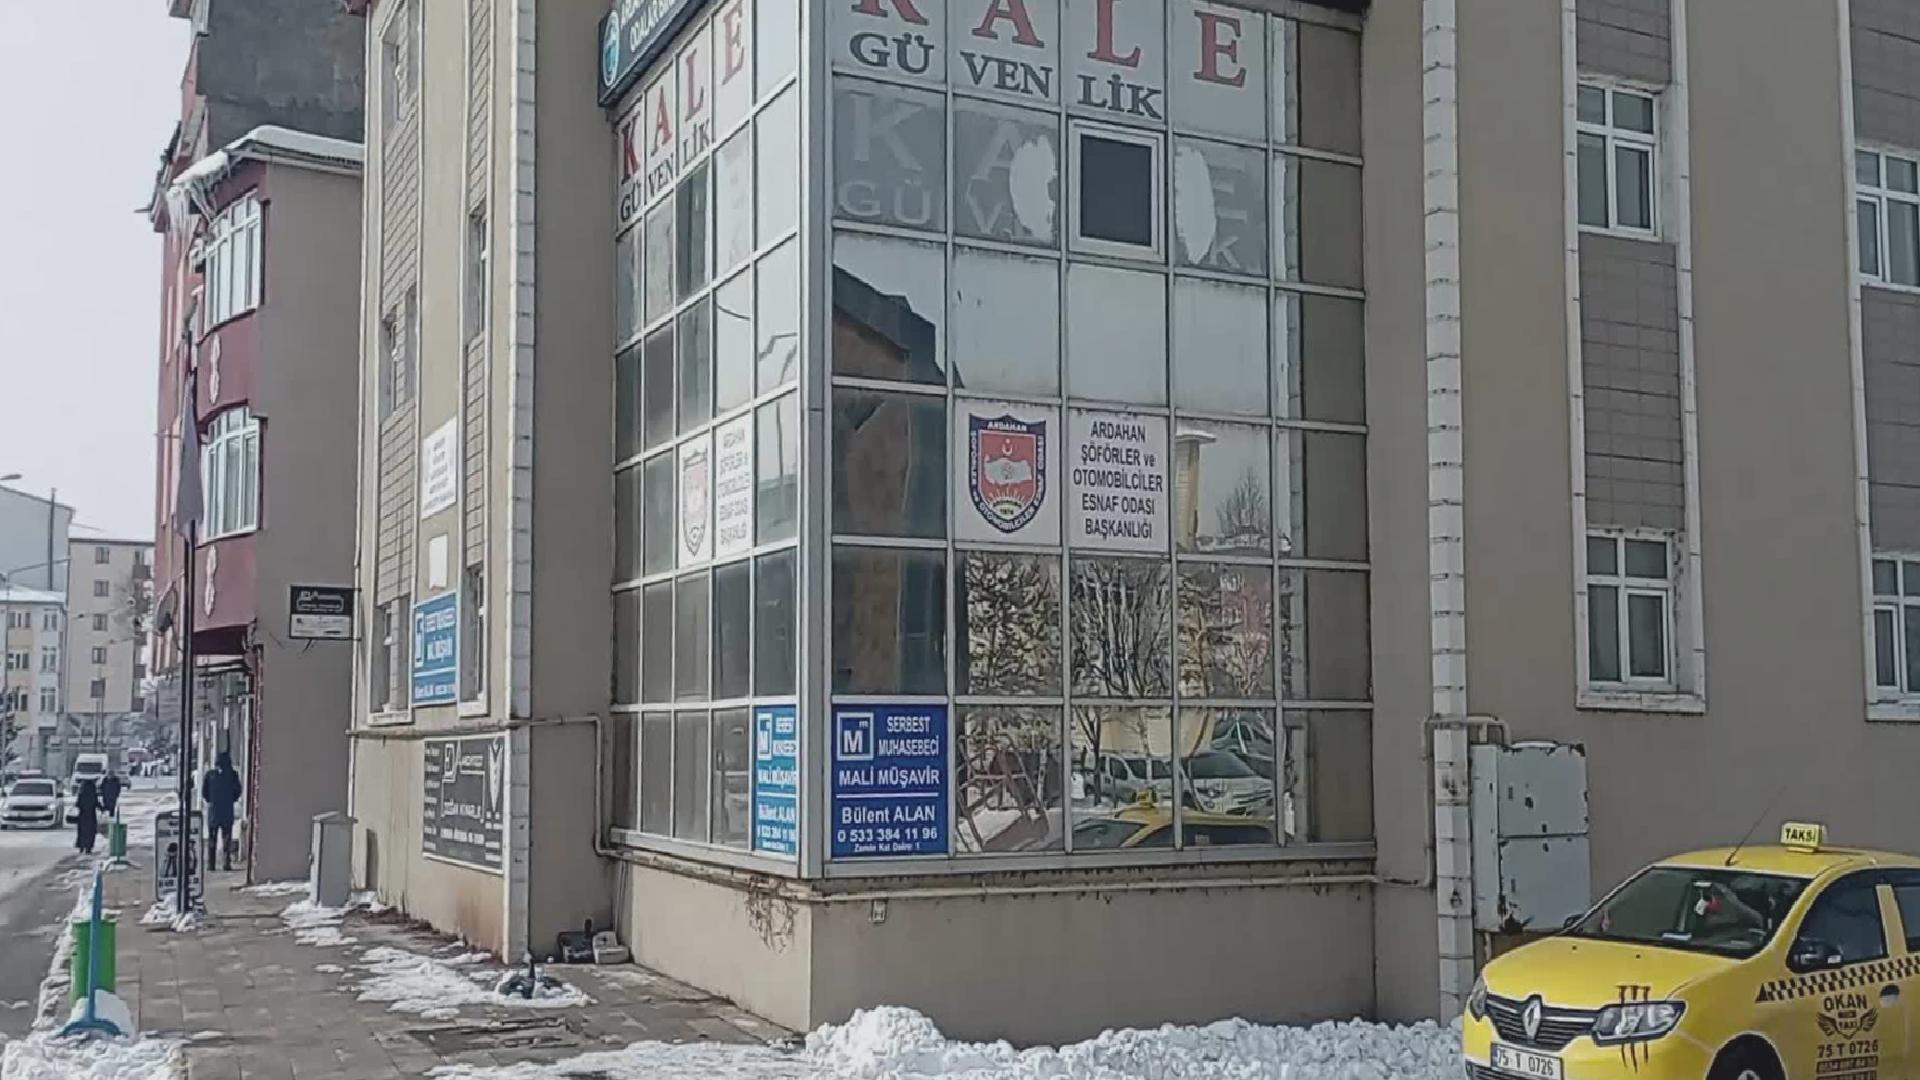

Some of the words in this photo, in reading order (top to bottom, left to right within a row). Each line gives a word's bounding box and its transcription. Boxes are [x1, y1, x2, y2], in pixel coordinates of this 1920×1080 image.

[1090, 420, 1146, 443] ARDAHAN
[1081, 441, 1141, 466] ŞÖFÖRLER
[1144, 453, 1156, 467] ve
[1073, 467, 1164, 493] OTOMOBİLCİLER
[1081, 493, 1119, 512] ESNAF
[1121, 496, 1156, 515] ODASI
[1084, 518, 1153, 540] BAŞKANLIĞI
[886, 716, 931, 733] SERBEST
[878, 734, 940, 757] MUHASEBECİ
[839, 764, 874, 786] MALİ
[878, 765, 940, 789] MÜŞAVİR
[842, 805, 890, 824] Bülent
[893, 804, 936, 822] ALAN
[849, 828, 874, 842] 533
[876, 827, 901, 842] 384
[904, 827, 919, 841] 11
[921, 826, 938, 840] 96
[1823, 993, 1867, 1012] OKAN
[1817, 1043, 1833, 1058] 75
[1837, 1042, 1845, 1057] T
[1849, 1039, 1879, 1055] 0726
[1528, 1055, 1554, 1076] 0726
